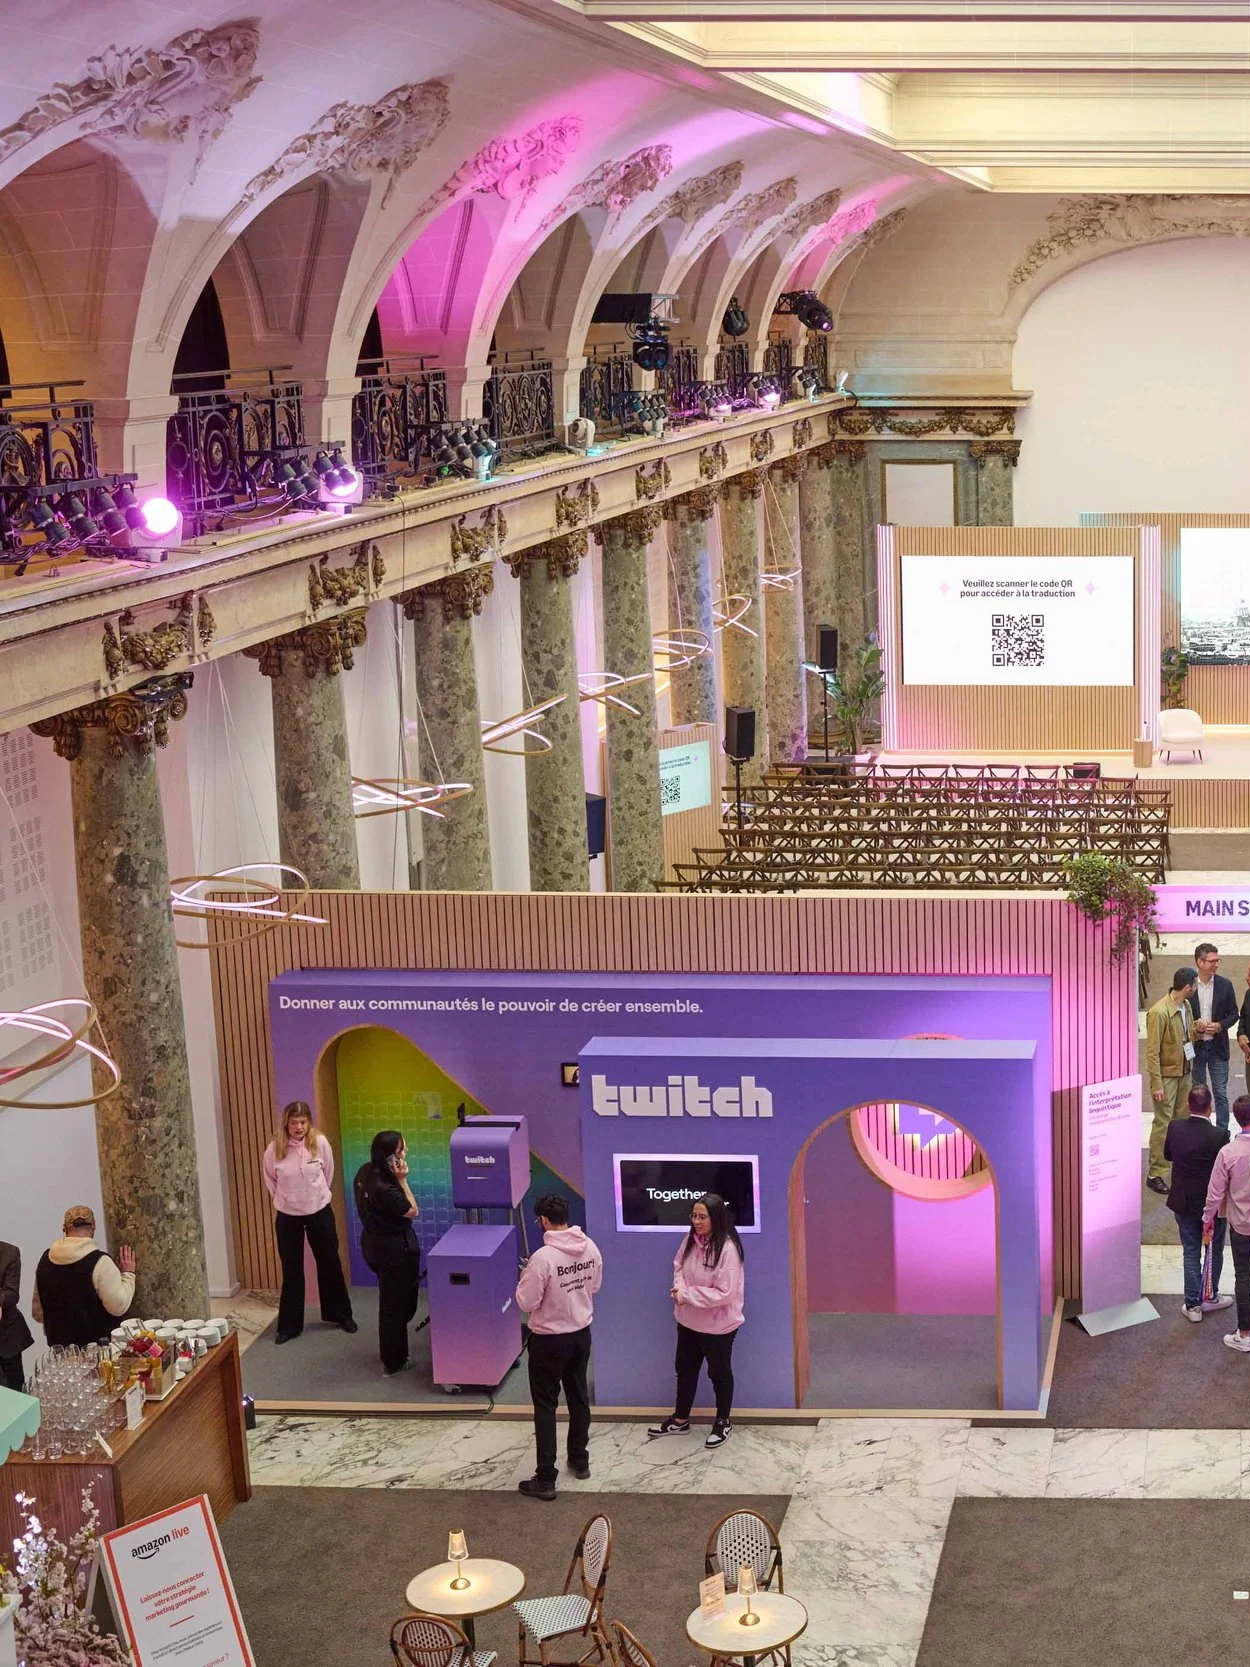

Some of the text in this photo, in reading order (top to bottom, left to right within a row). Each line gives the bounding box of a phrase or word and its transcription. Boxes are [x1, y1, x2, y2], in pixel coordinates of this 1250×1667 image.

[962, 579, 994, 588] Veuillez
[1030, 579, 1038, 588] le
[1039, 579, 1060, 588] code
[1060, 579, 1073, 589] QR
[960, 589, 1076, 598] pour accéder à la traduction
[1186, 900, 1234, 916] MAIN
[279, 996, 704, 1014] Donner aux communautés le pouvoir de créer ensemble.
[591, 1074, 774, 1118] twitch
[464, 1155, 496, 1164] twitch
[646, 1187, 707, 1202] Together
[131, 1526, 190, 1558] amazon live
[176, 1571, 204, 1588] concocter
[145, 1604, 175, 1621] marketing
